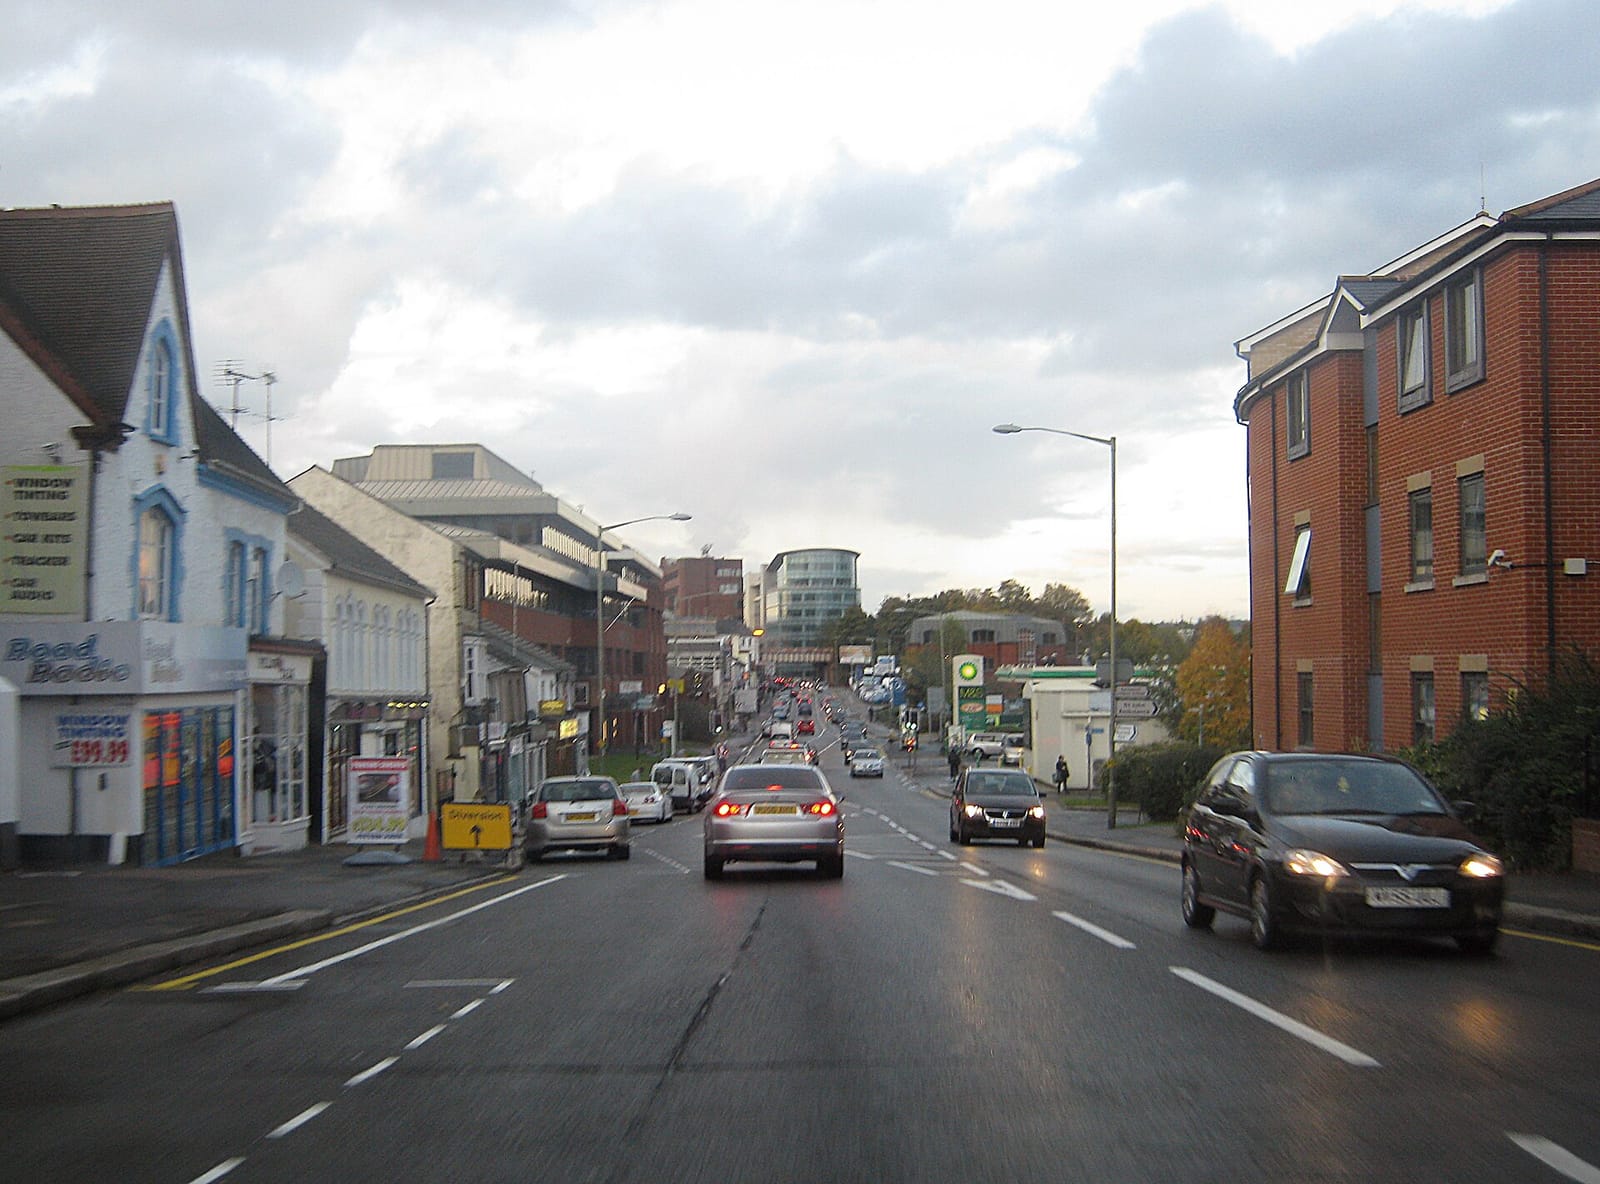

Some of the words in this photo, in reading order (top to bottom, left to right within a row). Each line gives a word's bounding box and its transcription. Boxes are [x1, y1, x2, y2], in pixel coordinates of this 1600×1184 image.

[14, 478, 75, 488] WINDOW
[14, 490, 69, 500] TINTING
[14, 511, 77, 521] TOWBARS
[13, 533, 38, 543] CAR
[42, 533, 73, 543] KITS
[12, 555, 71, 566] TRACKER
[11, 577, 37, 587] CAR
[10, 590, 54, 600] AUDIO
[7, 633, 97, 661] Road
[25, 658, 130, 684] Radio
[58, 715, 131, 725] WINDOW
[58, 727, 127, 738] TINTING
